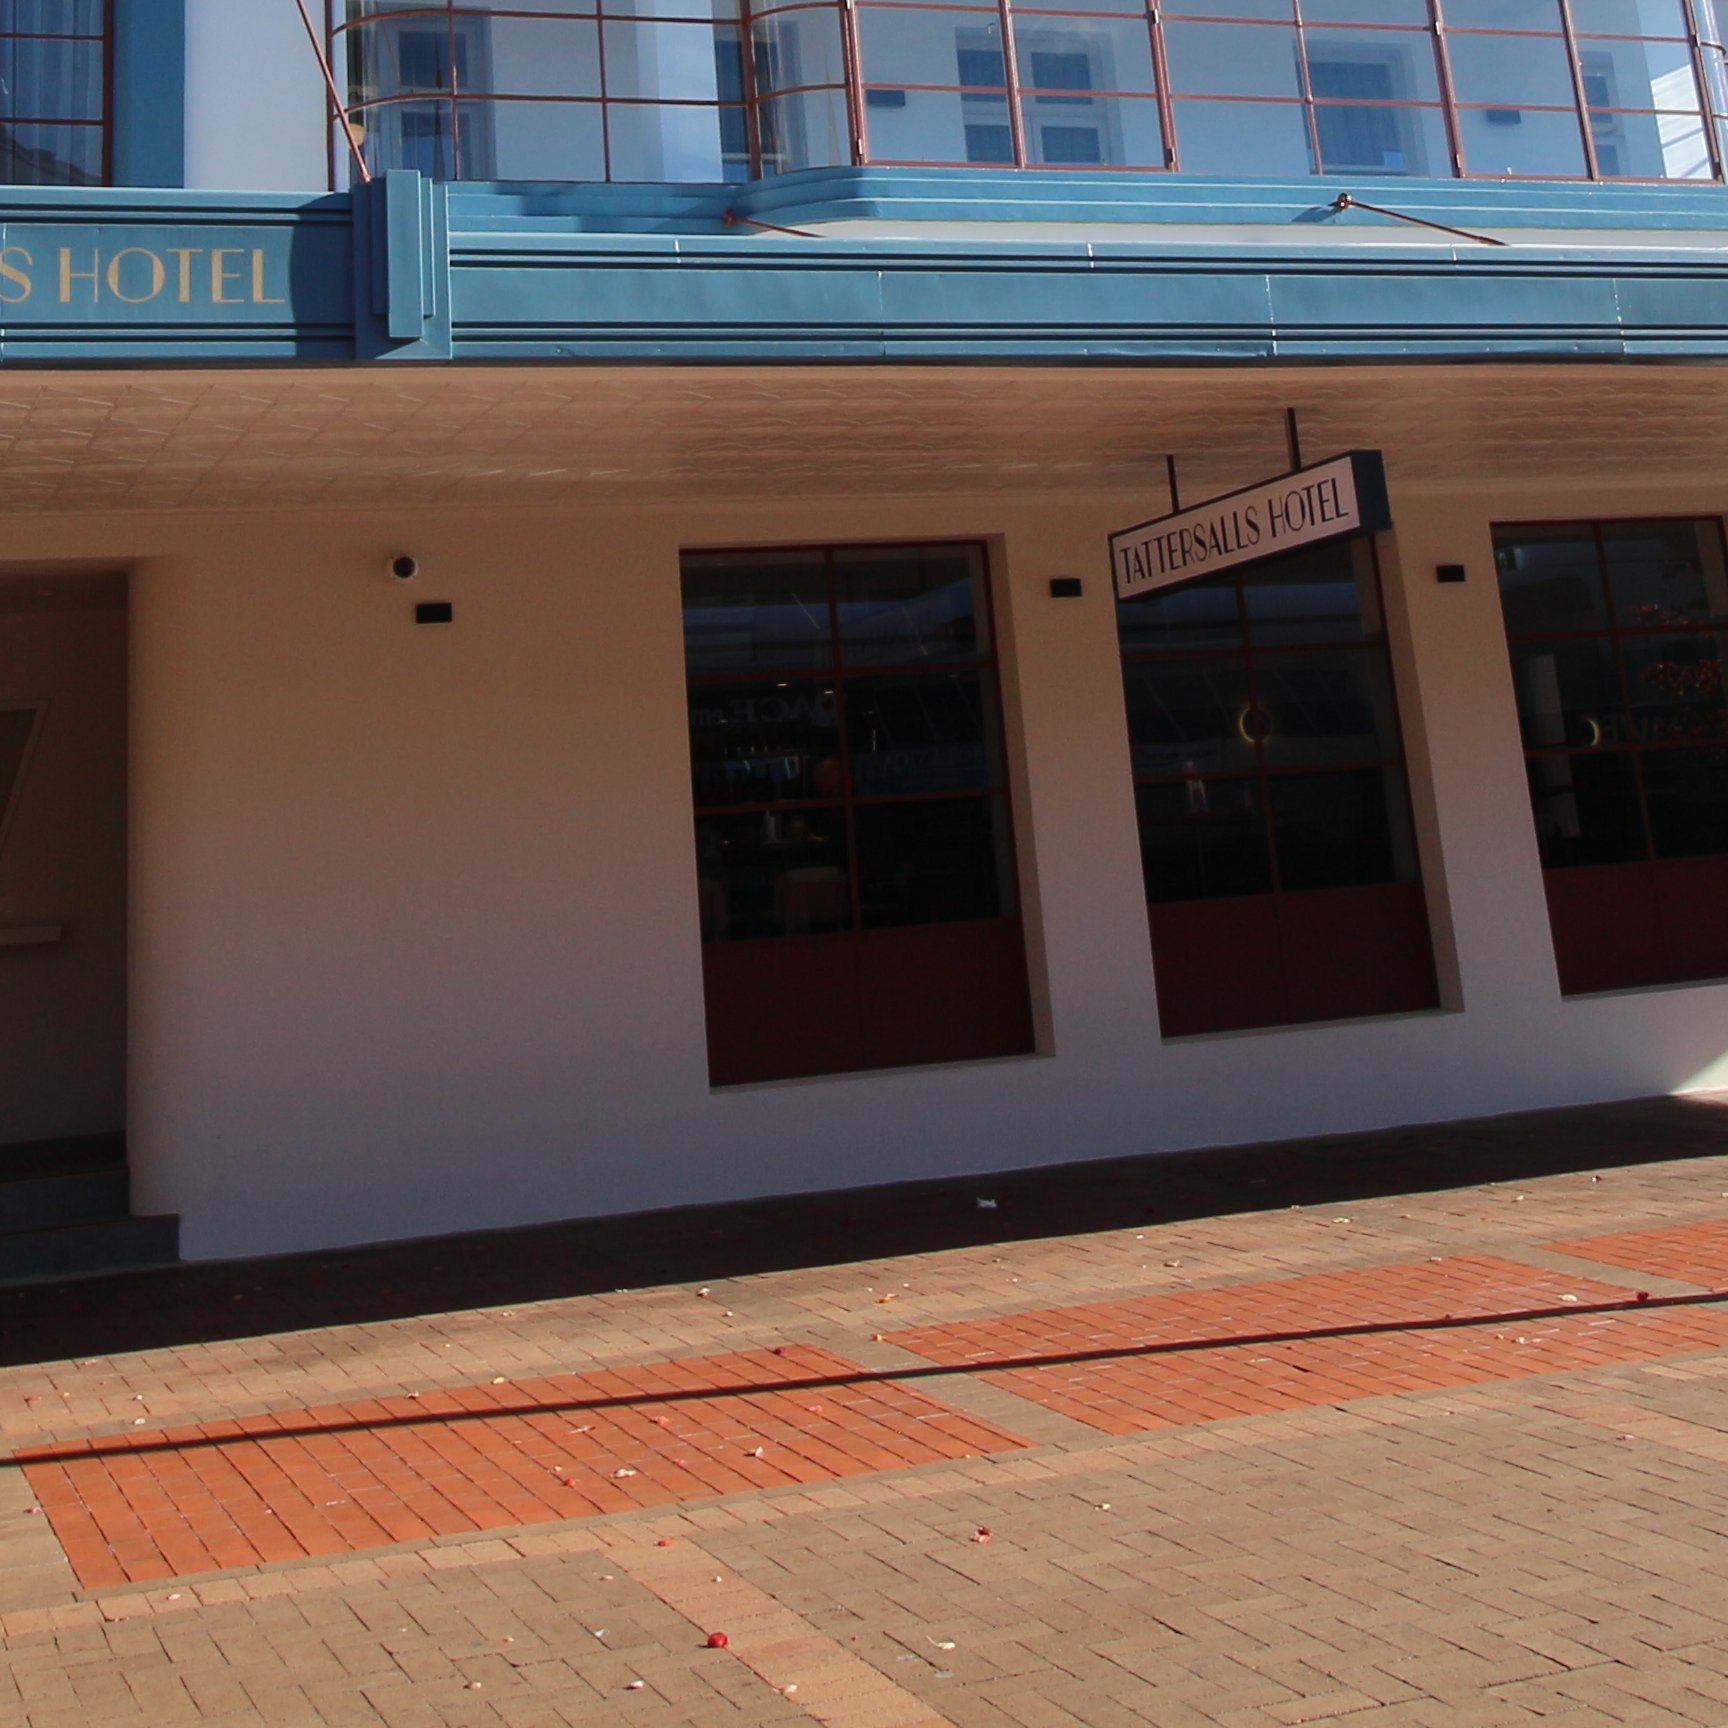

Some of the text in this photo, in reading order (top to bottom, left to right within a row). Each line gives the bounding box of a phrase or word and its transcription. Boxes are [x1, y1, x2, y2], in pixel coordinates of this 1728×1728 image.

[58, 247, 286, 304] HOTEL
[1120, 477, 1349, 584] TATTERSALLS HOTEL
